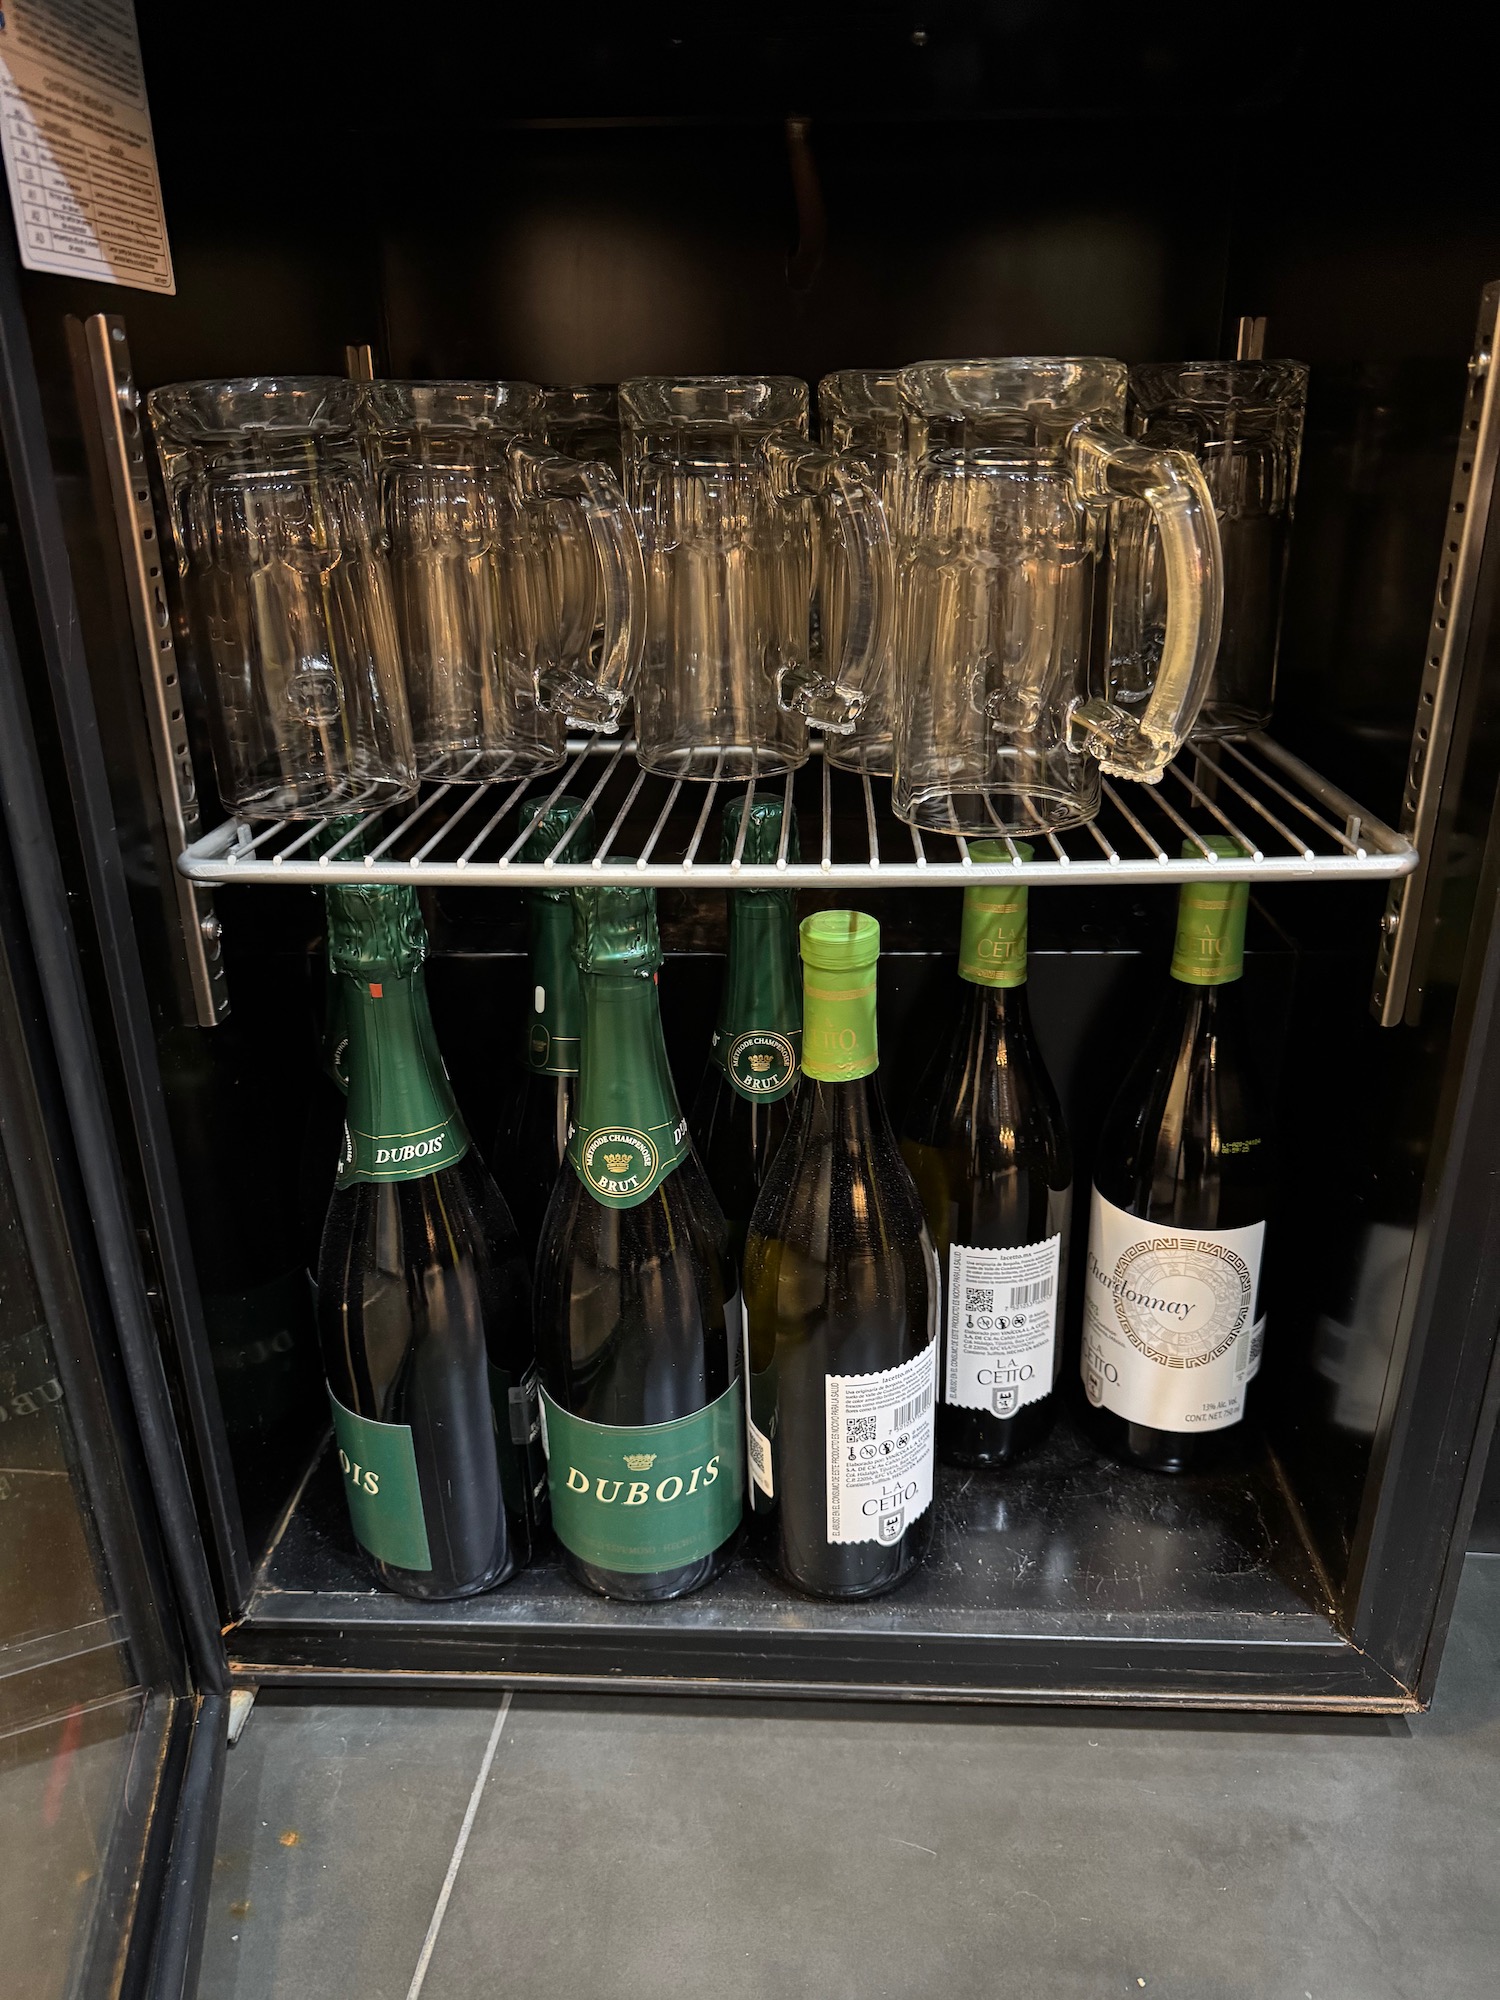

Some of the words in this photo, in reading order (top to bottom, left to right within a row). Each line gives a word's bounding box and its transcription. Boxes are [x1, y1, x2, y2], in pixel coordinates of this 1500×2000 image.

[753, 1037, 791, 1067] CHAMPENOISE
[743, 1073, 779, 1089] BRUT
[375, 1135, 444, 1165] DUBOIS
[586, 1135, 608, 1166] MÉTHODE
[608, 1134, 652, 1167] CHAMPENOISE
[597, 1174, 639, 1192] BRUT
[1087, 1250, 1196, 1321] Chardonnay
[996, 1358, 1018, 1369] LA
[977, 1364, 1033, 1385] CETTO
[1202, 1403, 1216, 1411] 13%
[846, 1459, 873, 1468] Elaborado
[565, 1454, 721, 1507] DUBOIS
[846, 1481, 871, 1489] Contiene
[882, 1480, 904, 1497] LA
[861, 1481, 917, 1517] CETTO
